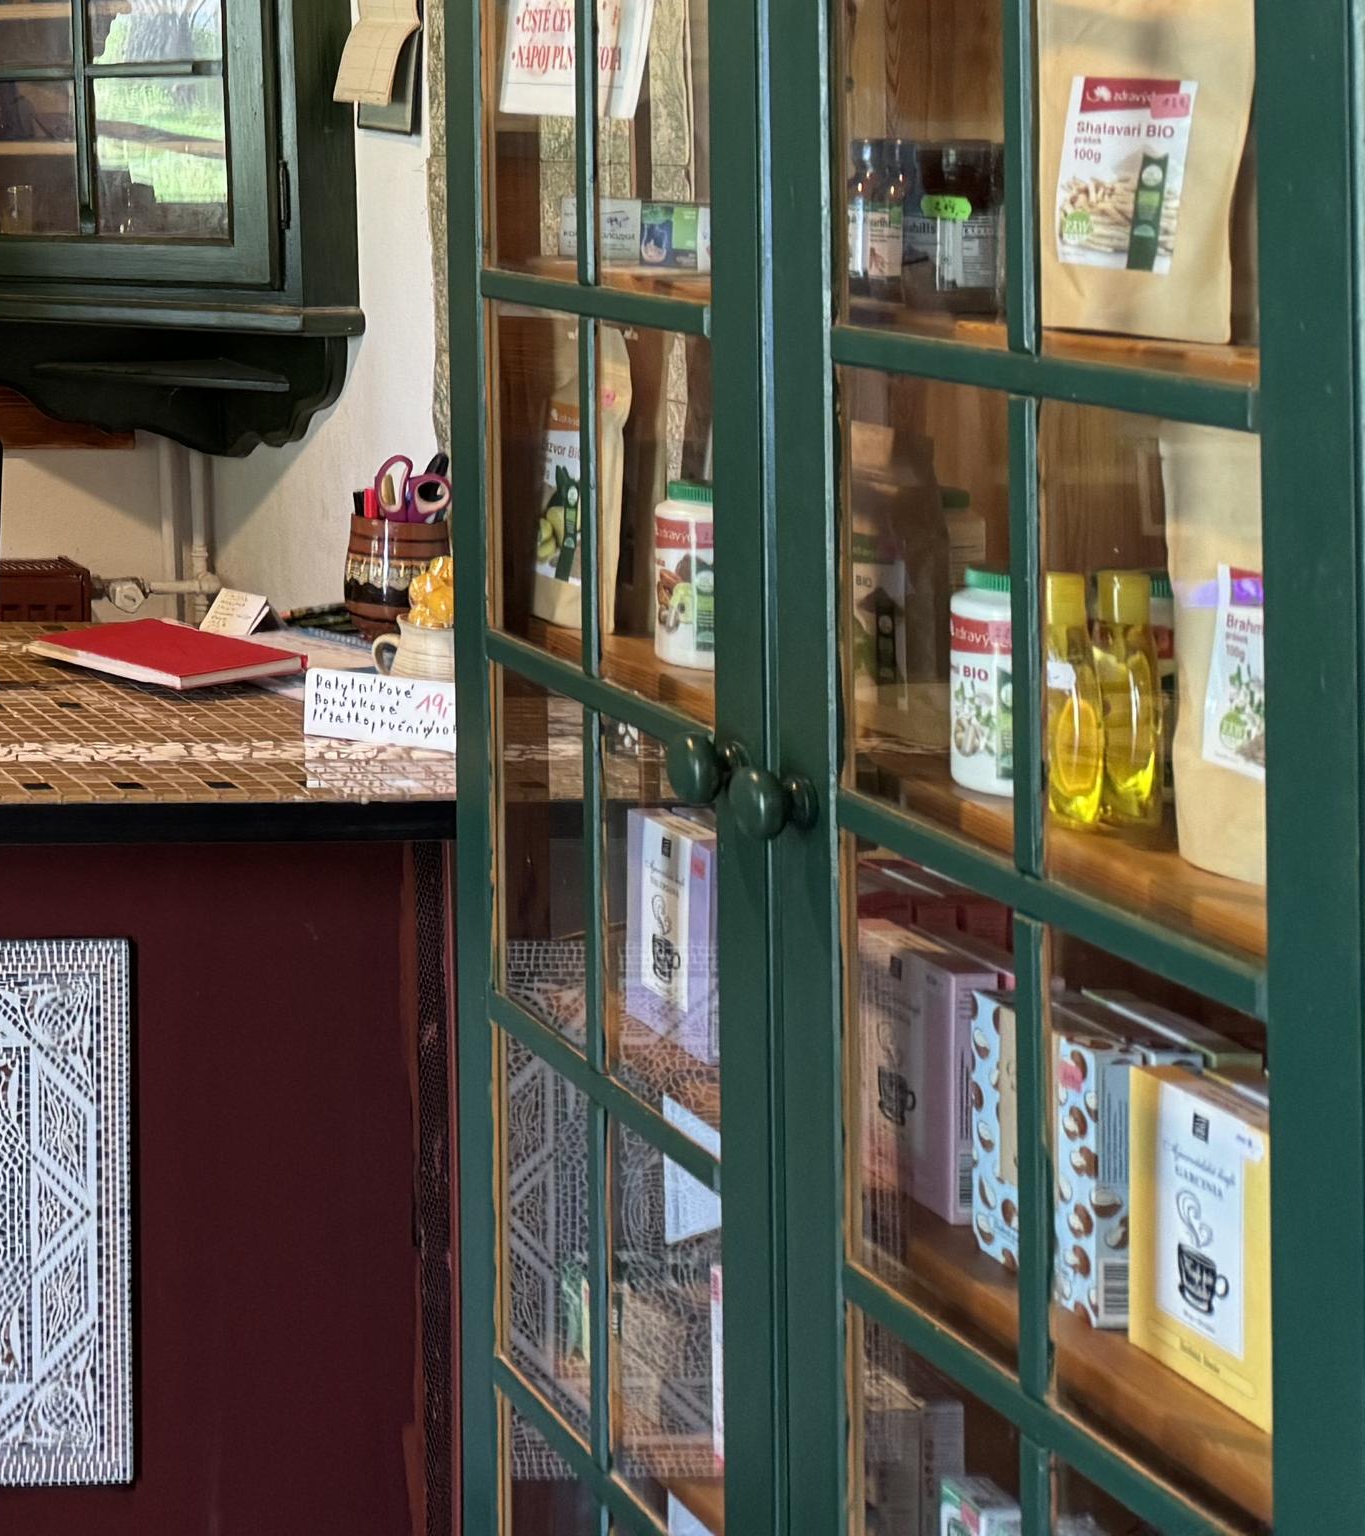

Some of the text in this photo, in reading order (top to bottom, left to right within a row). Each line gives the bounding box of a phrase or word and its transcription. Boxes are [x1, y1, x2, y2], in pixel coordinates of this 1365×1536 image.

[1076, 120, 1174, 139] Shatavari BIO
[1074, 148, 1103, 164] 100g
[963, 665, 989, 681] BIO
